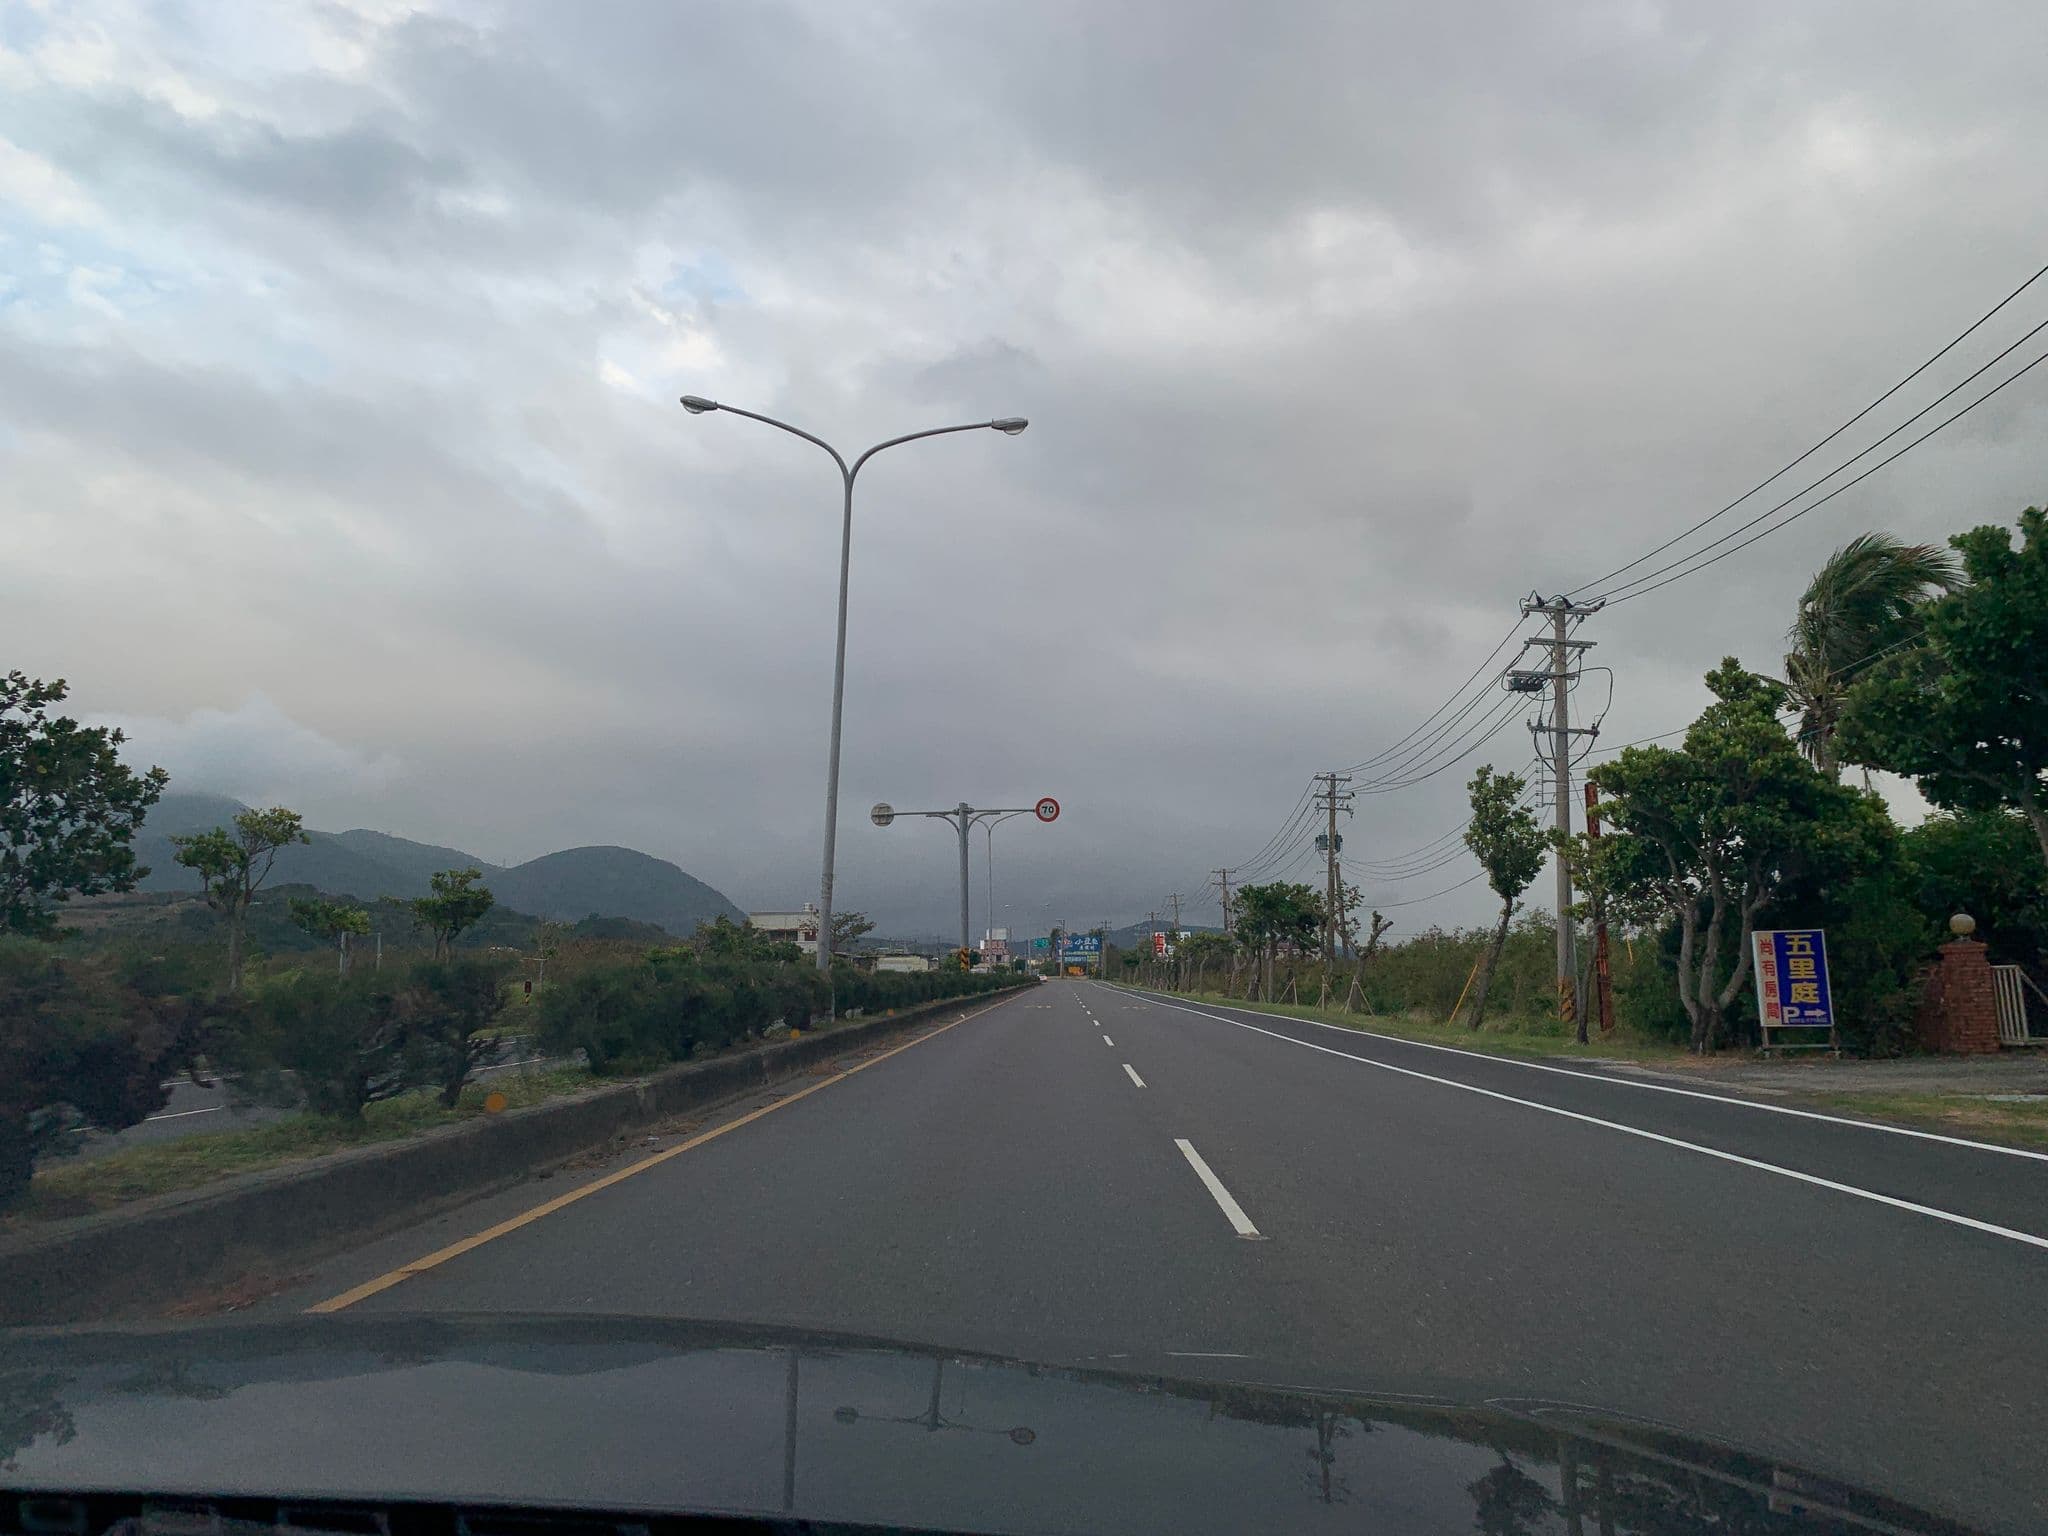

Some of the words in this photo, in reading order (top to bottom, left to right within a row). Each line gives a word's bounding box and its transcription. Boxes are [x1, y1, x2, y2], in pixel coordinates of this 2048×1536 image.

[1041, 806, 1054, 814] 70
[1784, 934, 1820, 1004] 五里庭
[1782, 1006, 1800, 1024] P
